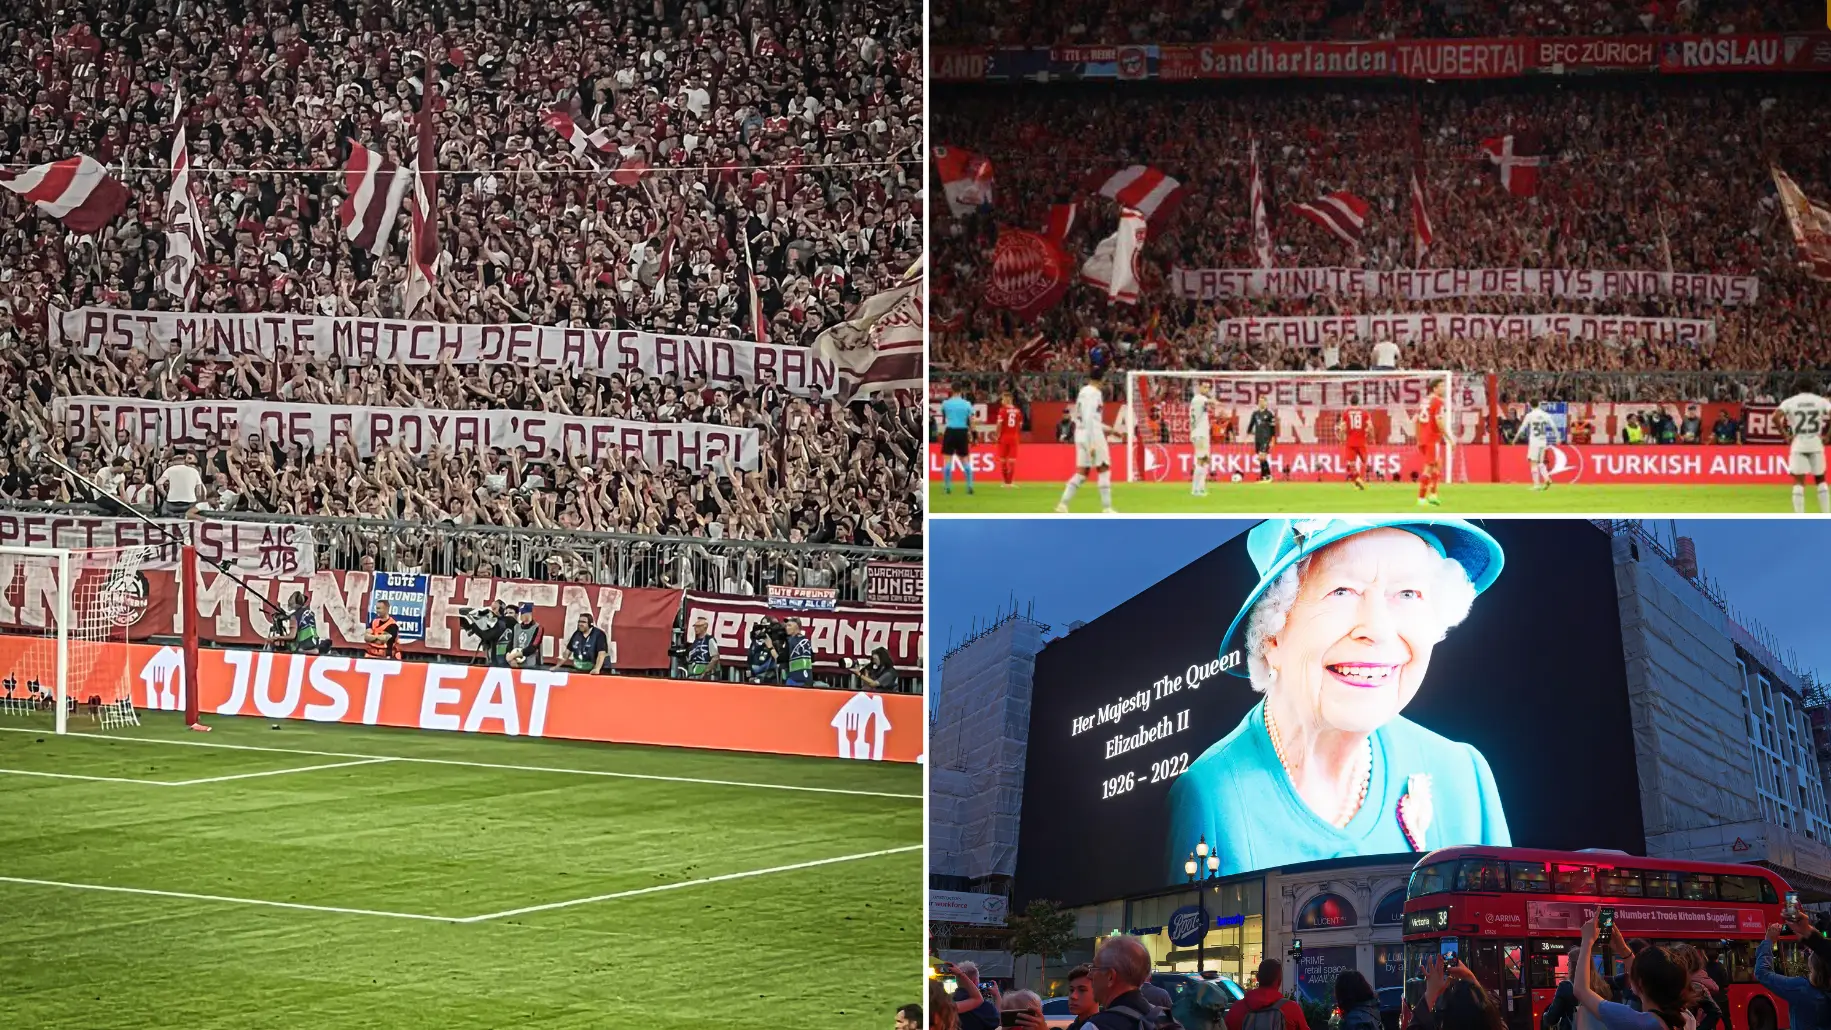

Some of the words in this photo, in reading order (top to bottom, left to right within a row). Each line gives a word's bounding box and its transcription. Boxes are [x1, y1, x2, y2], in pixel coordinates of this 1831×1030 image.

[1201, 42, 1387, 72] Sandharlanden
[1540, 43, 1577, 63] BFC
[1581, 39, 1653, 64] ZÜRICH
[1682, 37, 1778, 67] RÖSLAU
[1180, 271, 1253, 295] LAST
[1266, 268, 1365, 294] MINUTE
[1379, 269, 1471, 293] MATCH
[1481, 268, 1593, 294] DELAYS
[1603, 271, 1659, 297] AND
[1671, 274, 1748, 300] BANS
[1227, 320, 1358, 345] BECAUSE
[1372, 319, 1409, 343] OF
[1421, 317, 1437, 343] A
[57, 311, 158, 351] LAST
[176, 316, 315, 356] MINUTE
[332, 319, 463, 361] MATCH
[481, 324, 640, 369] DELAYS
[655, 337, 736, 382] AND
[69, 404, 237, 446] BECAUSE
[330, 413, 353, 456] A
[1794, 409, 1820, 434] 23
[1591, 454, 1701, 476] TURKISH
[387, 575, 416, 588] GUTE
[374, 589, 424, 603] FREUNDE
[401, 606, 421, 617] NIE
[216, 649, 401, 727] JUST
[418, 663, 569, 738] EAT
[1071, 714, 1096, 737] Her
[1097, 689, 1151, 726] Majesty
[1153, 674, 1183, 701] The
[1186, 649, 1241, 690] Queen
[1105, 715, 1173, 760] Elizabeth
[1177, 709, 1191, 733] II
[1102, 771, 1135, 800] 1926
[1151, 752, 1189, 784] 2022
[935, 901, 968, 909] workforce
[1620, 909, 1651, 920] Number
[1656, 911, 1678, 921] Trade
[1678, 911, 1706, 922] Kitchen
[1706, 912, 1736, 923] Supplier
[1313, 916, 1341, 926] LUCENT
[1437, 910, 1448, 926] 38
[1494, 914, 1521, 923] ARRIVA
[1541, 942, 1550, 951] 38
[1301, 955, 1325, 965] PRIME
[1304, 965, 1322, 974] retail
